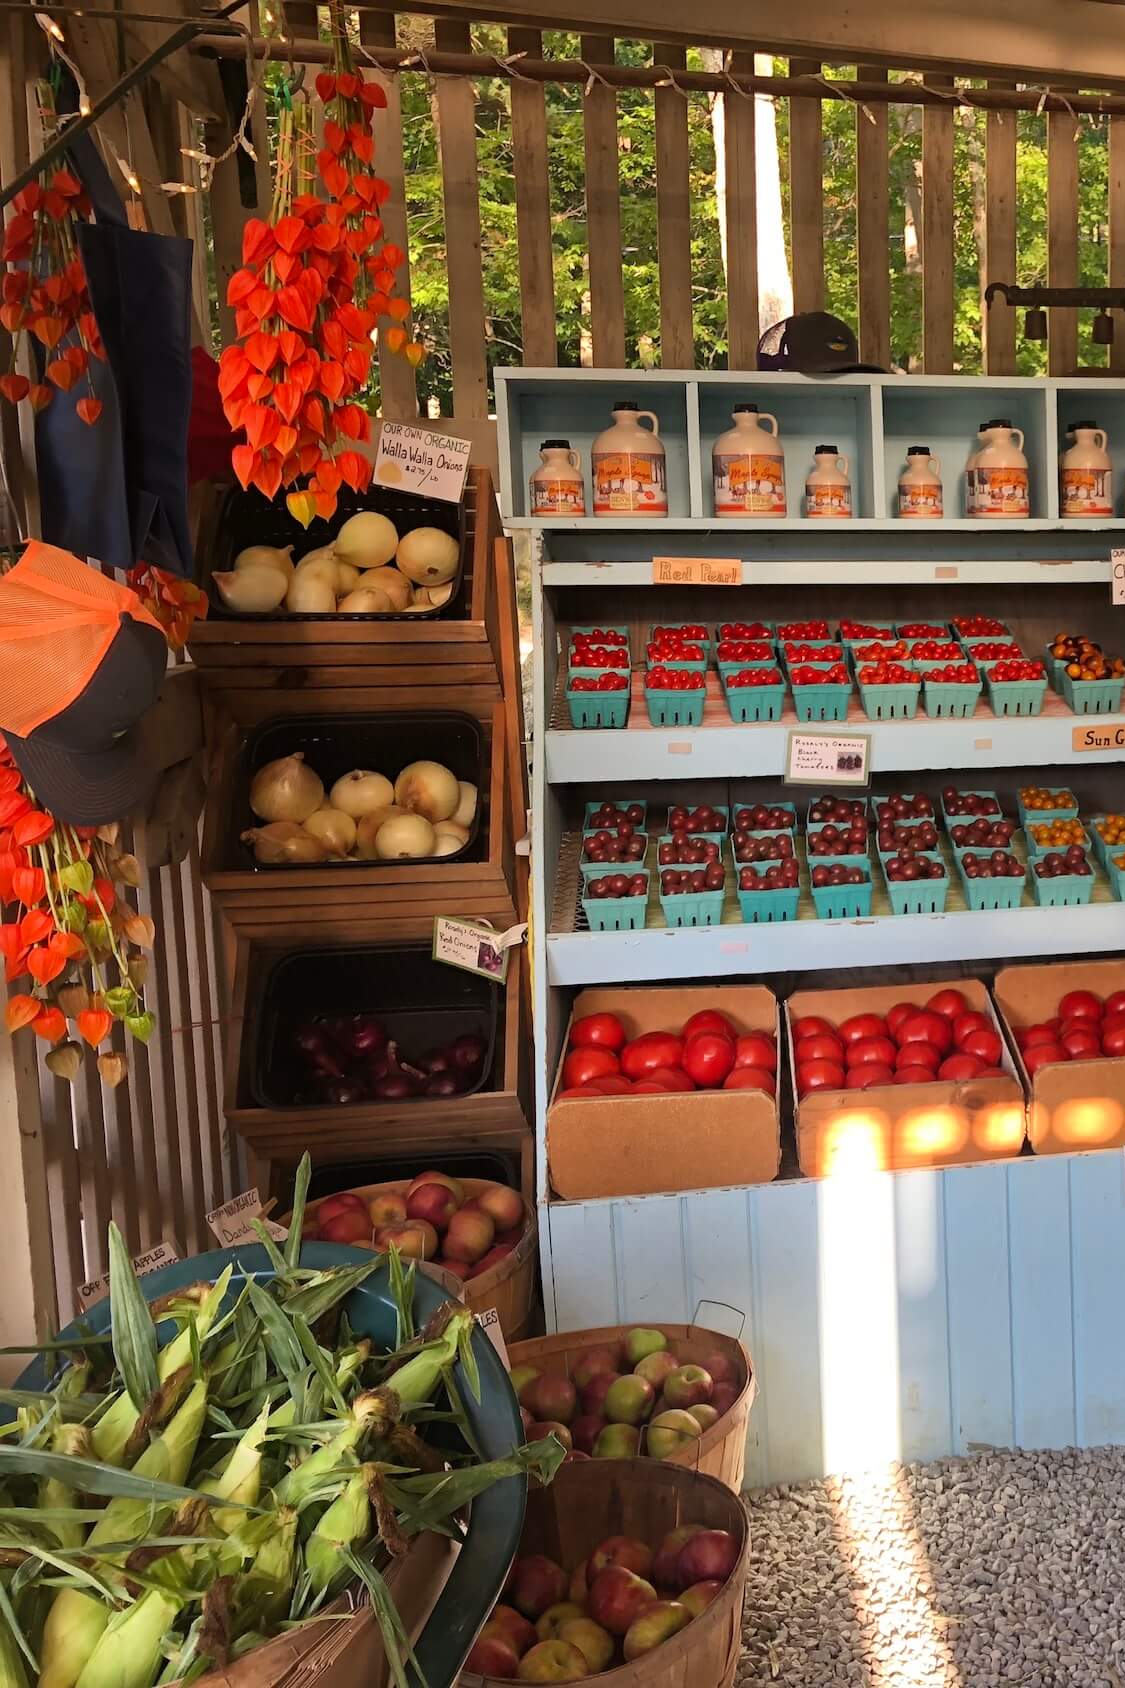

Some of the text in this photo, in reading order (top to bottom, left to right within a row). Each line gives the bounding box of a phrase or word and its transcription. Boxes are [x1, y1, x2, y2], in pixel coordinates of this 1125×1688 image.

[384, 423, 469, 454] OUR OWN ORGANIC
[382, 438, 463, 471] Walla Walla Onions
[659, 561, 738, 583] Red Pearl
[1084, 730, 1110, 746] Sun
[133, 1247, 166, 1272] APPLES
